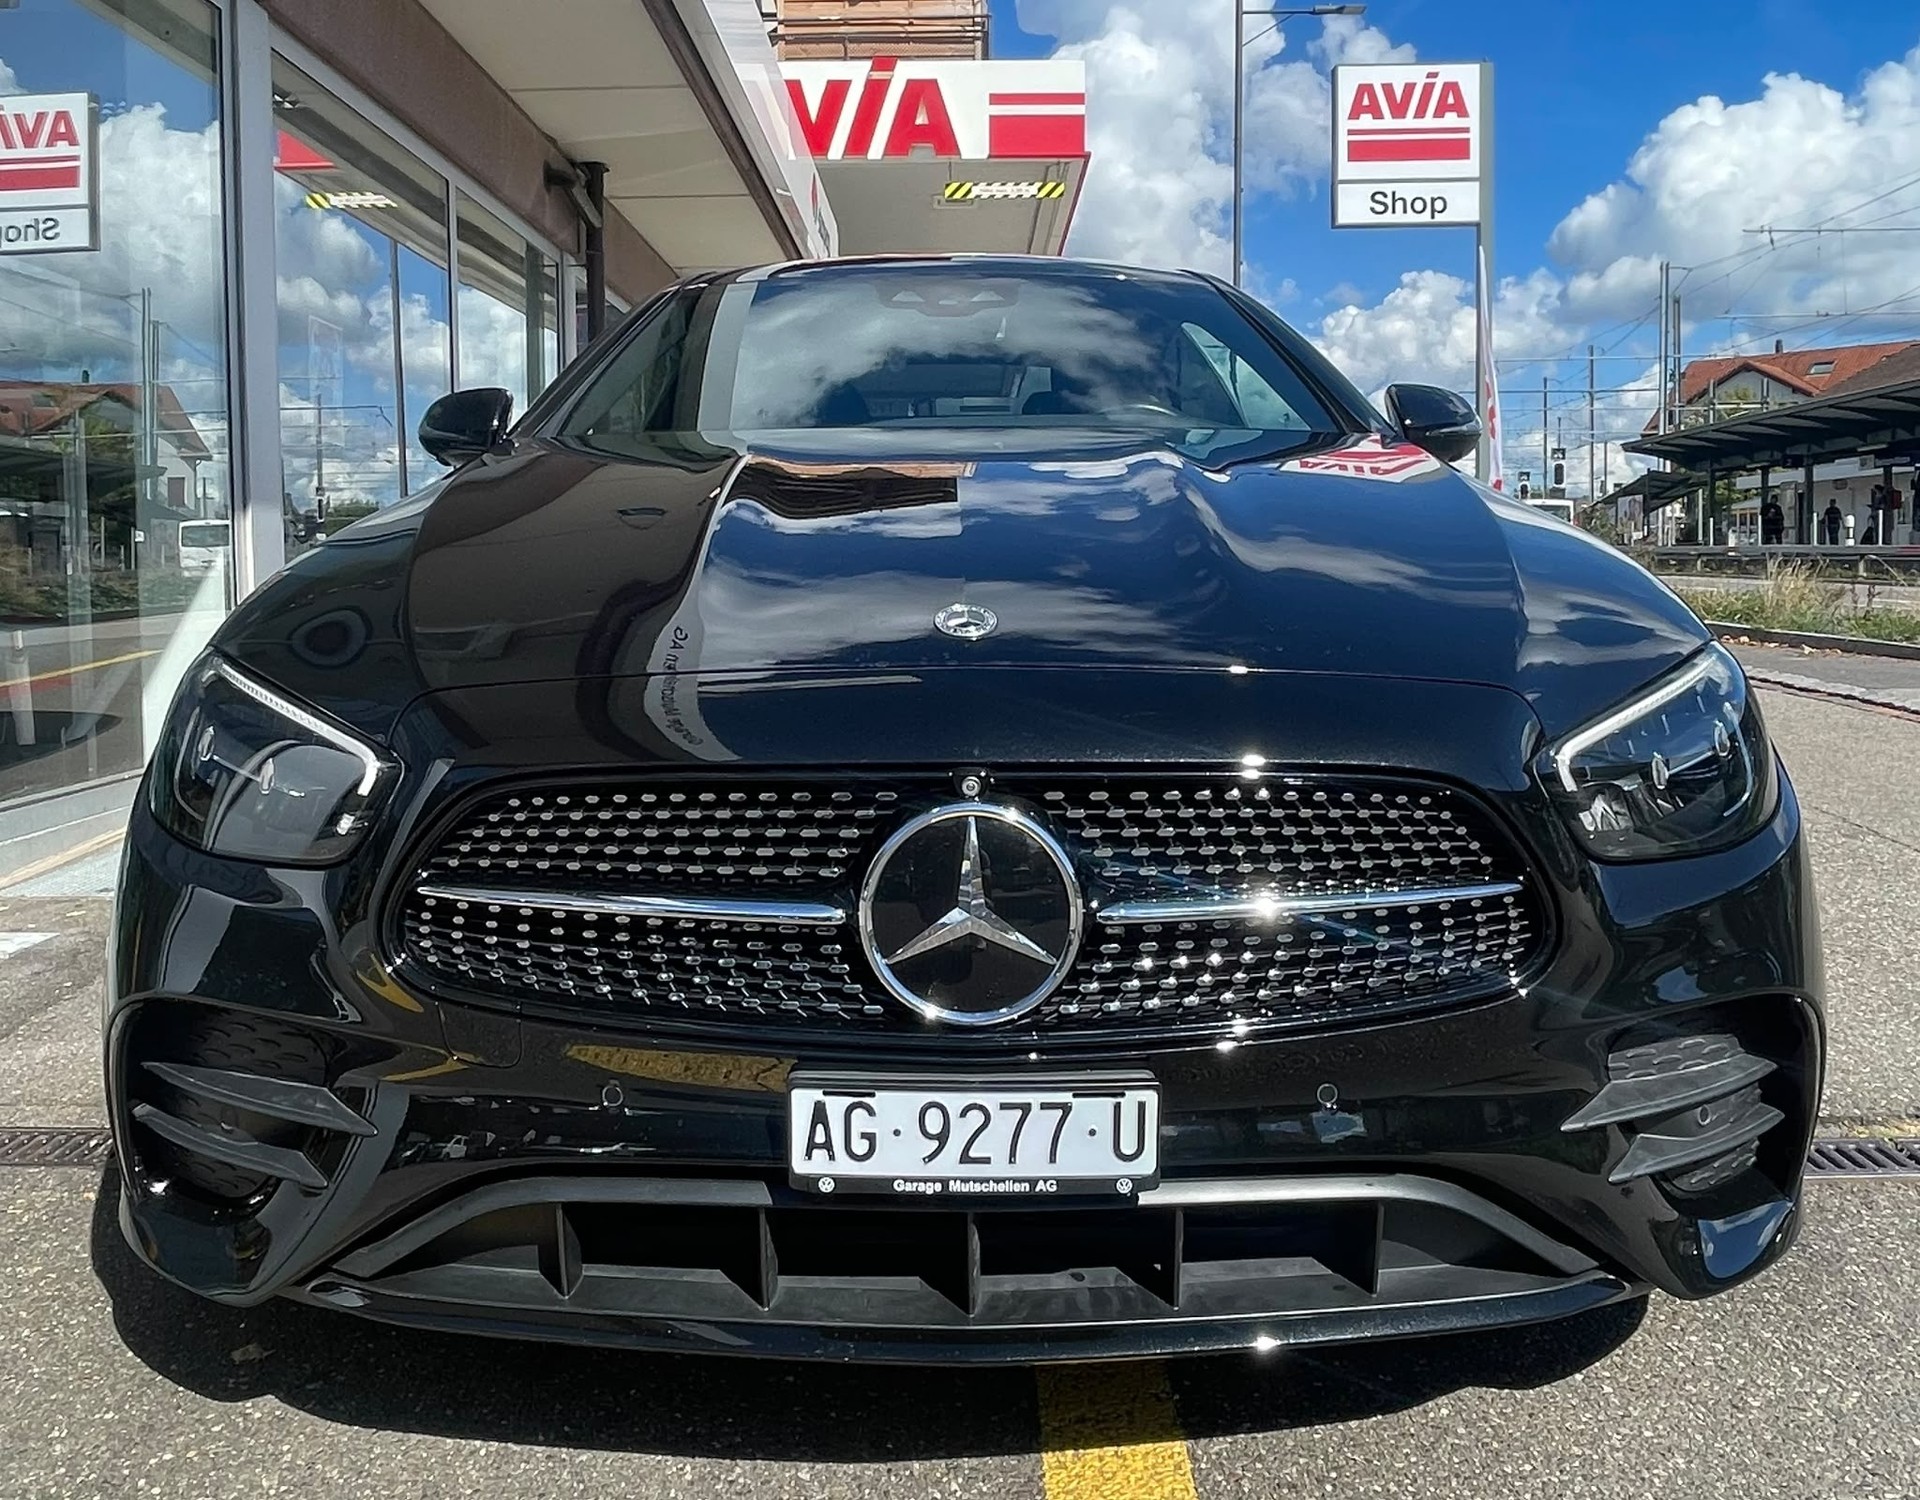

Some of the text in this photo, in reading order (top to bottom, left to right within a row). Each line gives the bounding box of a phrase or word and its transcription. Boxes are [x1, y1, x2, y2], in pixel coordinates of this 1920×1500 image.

[1347, 72, 1470, 120] AVIA
[1369, 190, 1447, 220] Shop
[804, 1100, 1146, 1165] AG 9277 U
[892, 1178, 943, 1195] Garage
[1034, 1179, 1058, 1193] AG
